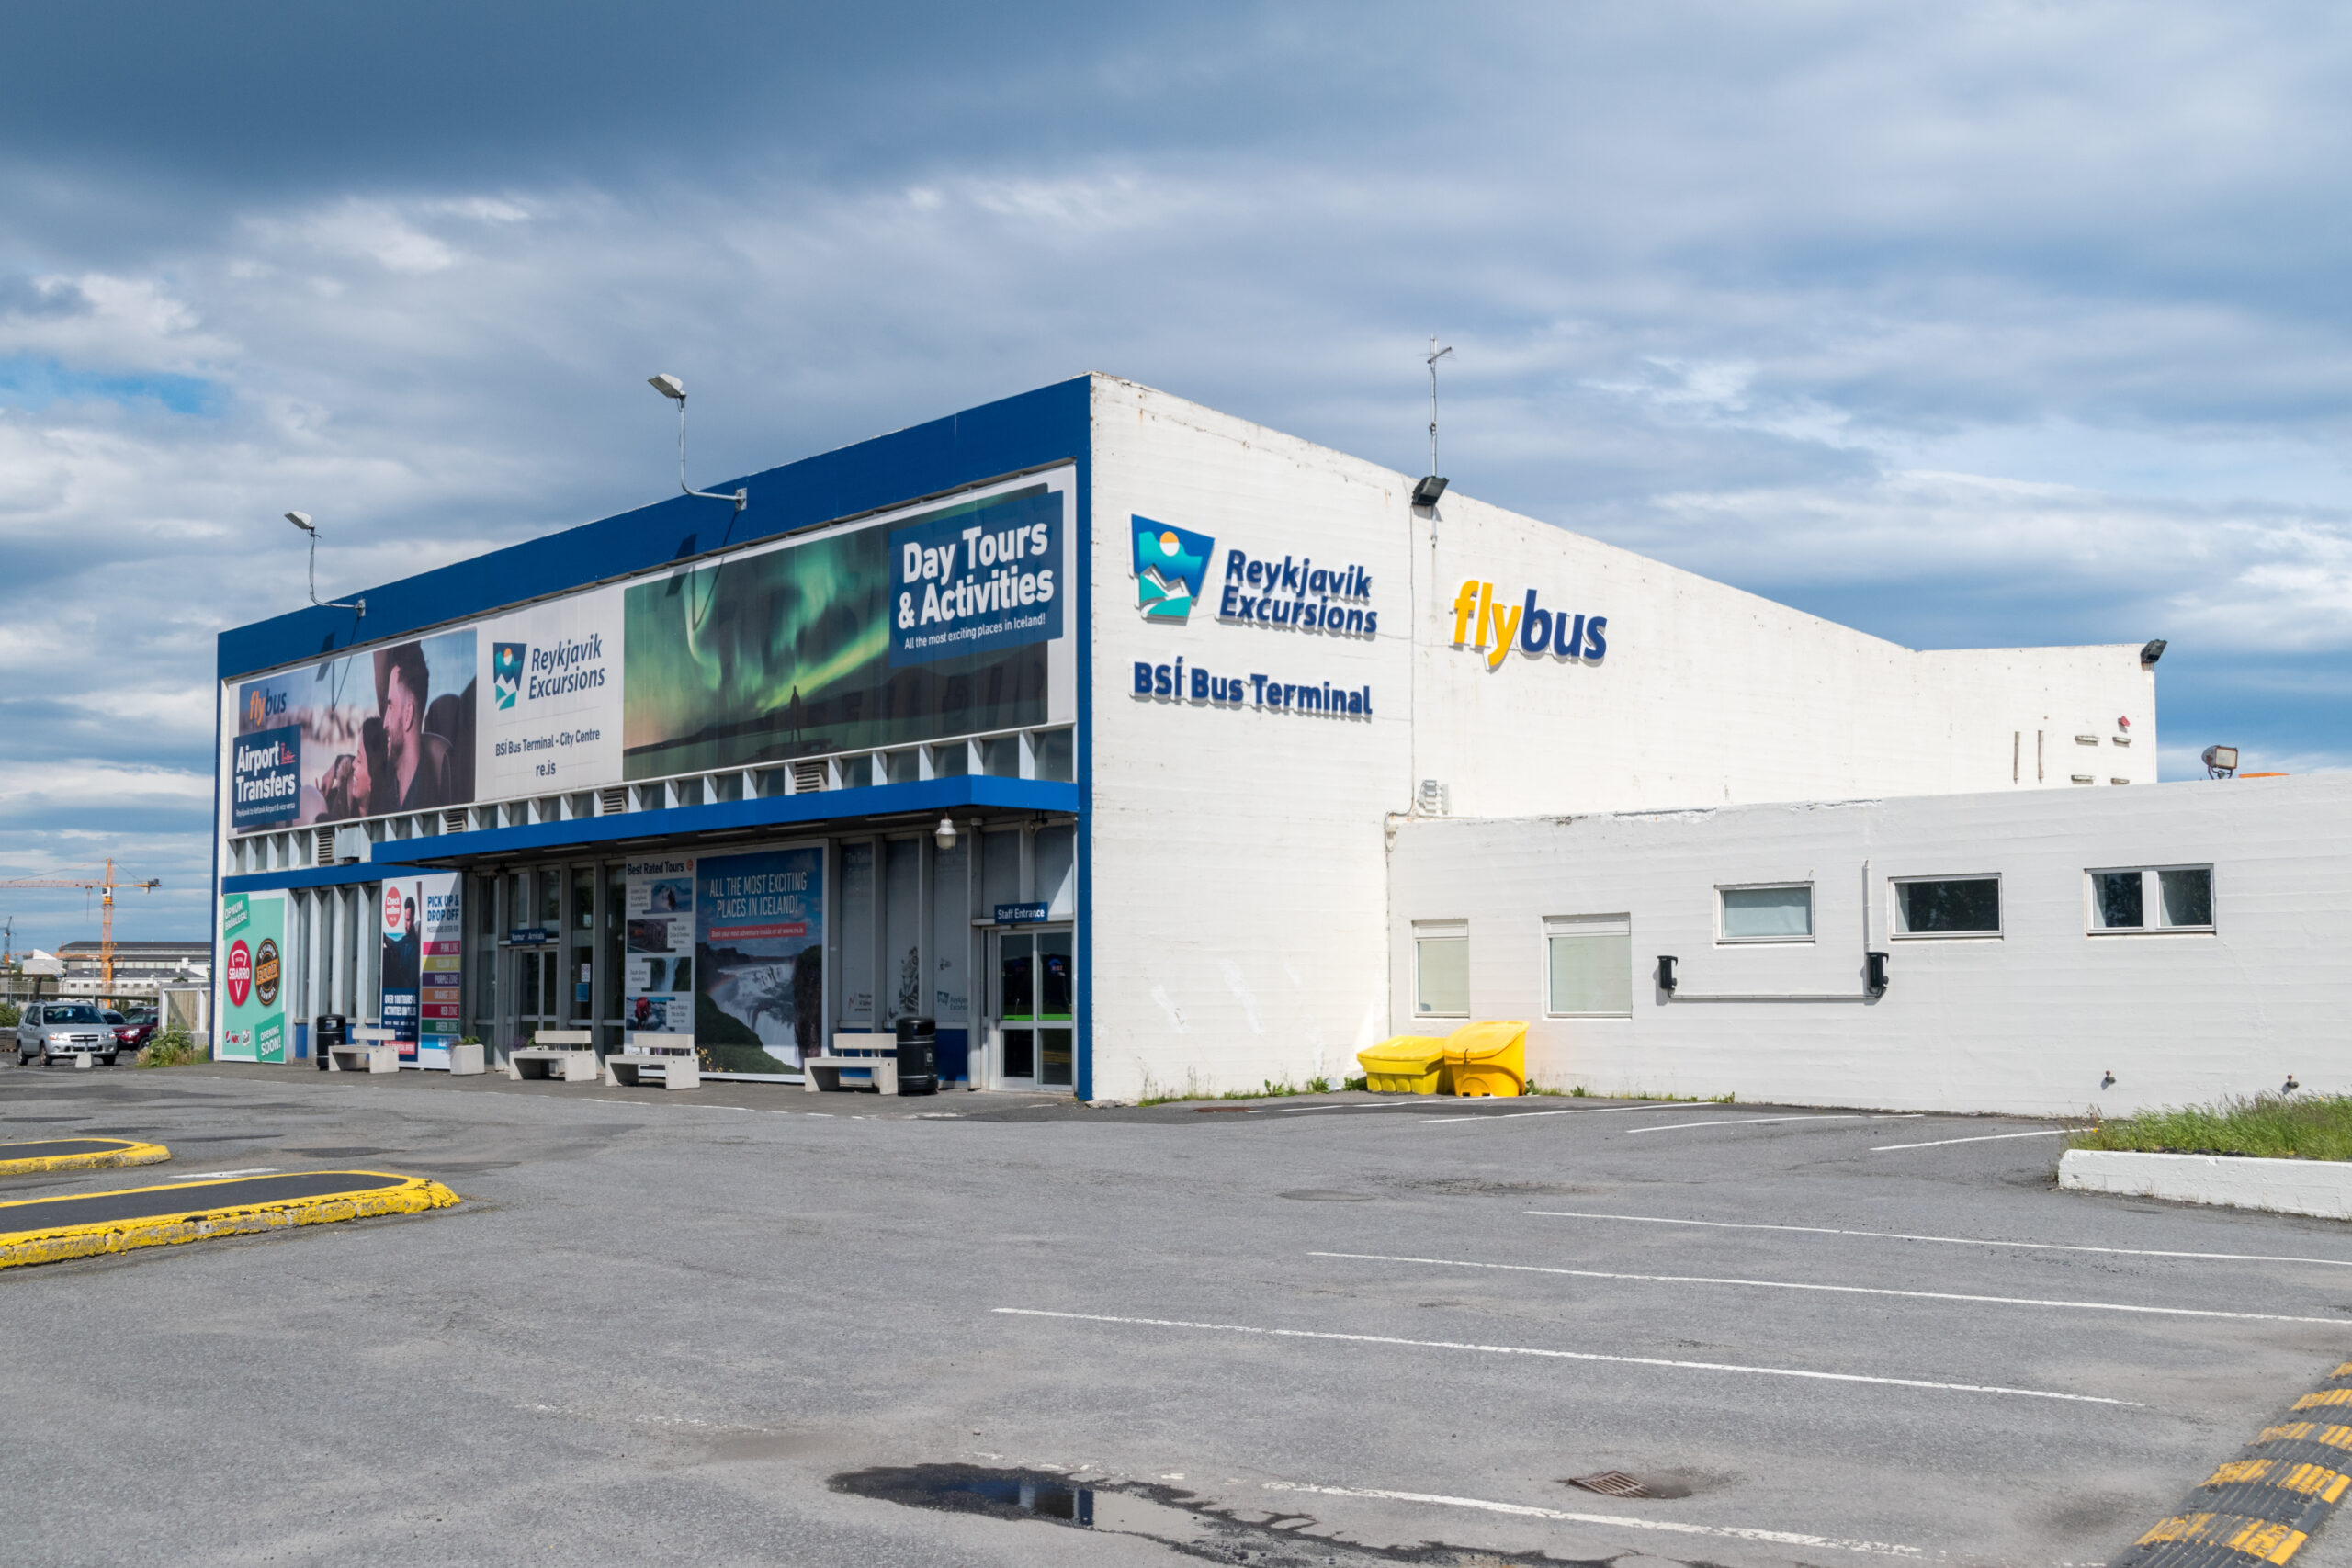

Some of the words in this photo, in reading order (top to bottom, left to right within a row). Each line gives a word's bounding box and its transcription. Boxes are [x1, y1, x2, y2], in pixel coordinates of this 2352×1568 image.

[903, 542, 956, 586] Day
[962, 523, 1048, 570] Tours
[1225, 549, 1373, 598] Reykjavik
[898, 592, 916, 630] &
[920, 564, 1055, 626] Activities
[1220, 585, 1378, 633] Excursions
[905, 638, 915, 650] All
[916, 635, 927, 648] the
[928, 633, 947, 646] most
[948, 627, 976, 642] exciting
[978, 623, 1003, 638] places
[1004, 620, 1012, 632] in
[1013, 613, 1046, 630] Iceland!
[1453, 580, 1608, 666] flybus
[531, 632, 602, 675] Reykjavik
[529, 666, 605, 700] Excursions
[1134, 655, 1183, 697] BSÍ
[1191, 667, 1244, 702] Bus
[1250, 674, 1373, 715] Terminal
[249, 688, 287, 726] flybus
[496, 739, 508, 756] BSÍ
[509, 741, 521, 755] Bus
[522, 735, 554, 752] Terminal
[560, 732, 574, 747] City
[576, 728, 600, 743] Centre
[236, 741, 279, 777] Airport
[536, 759, 556, 777] re.is
[236, 770, 295, 802] Transfers
[627, 863, 642, 875] Best
[644, 862, 664, 874] Rated
[665, 860, 684, 872] Tours
[709, 878, 724, 897] ALL
[726, 877, 741, 896] THE
[744, 874, 767, 895] MOST
[769, 871, 807, 893] EXCITING
[427, 895, 443, 908] PICK
[444, 895, 453, 907] UP
[427, 909, 445, 922] DROP
[446, 908, 459, 921] OFF
[716, 899, 746, 918] PLACES
[749, 897, 757, 916] IN
[760, 894, 798, 916] ICELAND!
[998, 909, 1013, 919] Staff
[1015, 908, 1045, 918] Entrance
[228, 967, 250, 980] SBARRO
[260, 1024, 280, 1041] OPENING
[261, 1036, 281, 1056] SOON!
